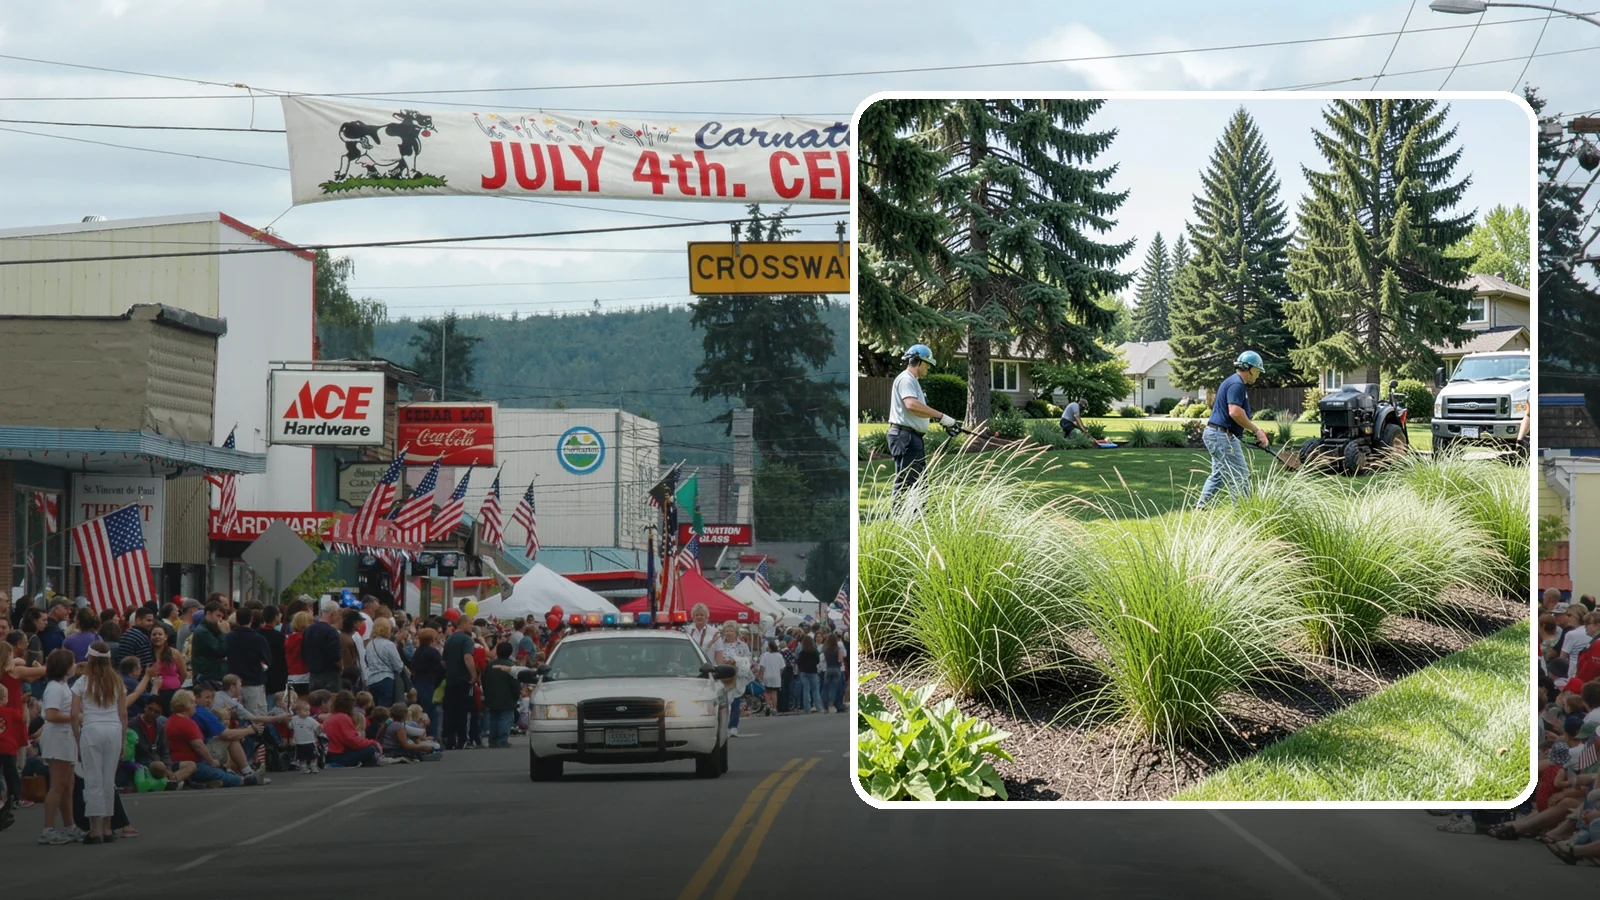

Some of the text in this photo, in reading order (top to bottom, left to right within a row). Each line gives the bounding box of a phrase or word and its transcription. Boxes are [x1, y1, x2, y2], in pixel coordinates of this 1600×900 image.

[481, 141, 604, 192] JULY
[632, 150, 746, 198] 4th.
[697, 254, 850, 280] CROSSWA
[283, 380, 373, 420] ACE
[405, 409, 452, 422] CEDAR
[283, 421, 371, 436] Hardware
[353, 467, 384, 480] Simpl
[95, 485, 124, 495] Vincent
[126, 486, 136, 495] de
[137, 486, 155, 495] Paul
[688, 526, 741, 535] CRNATION
[699, 535, 730, 543] GLASS
